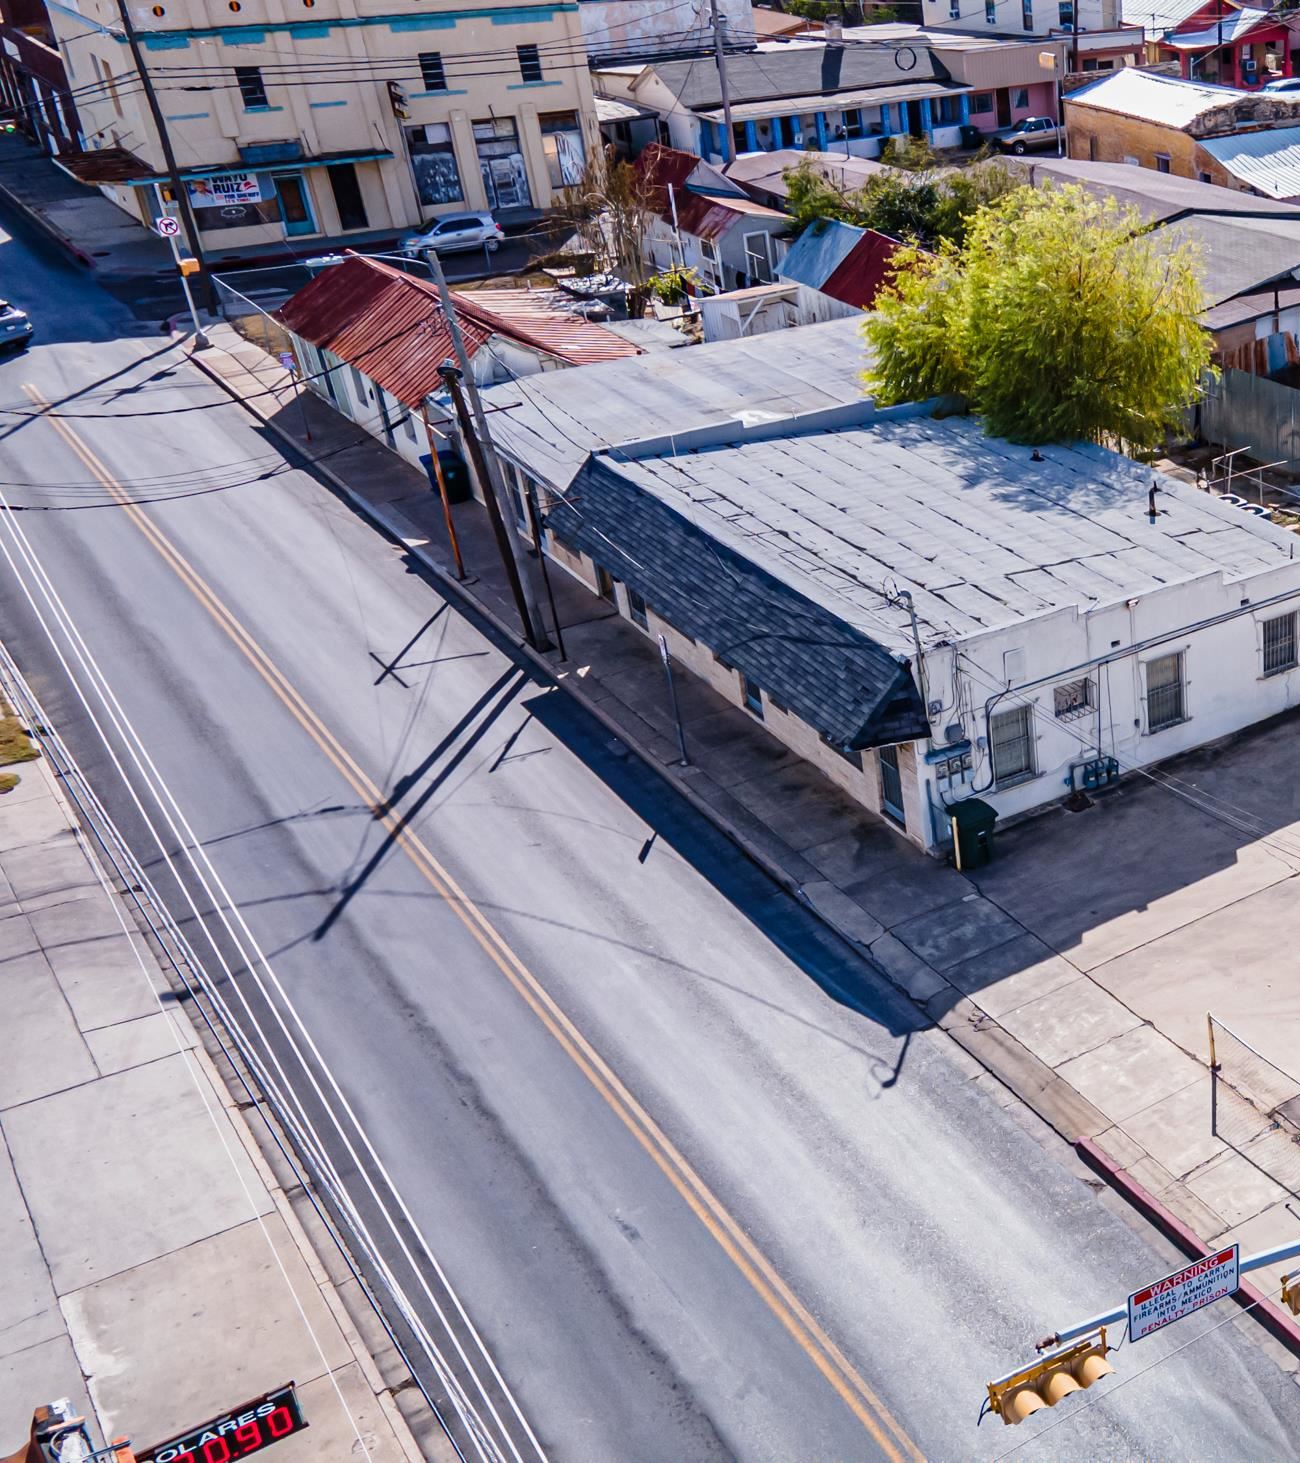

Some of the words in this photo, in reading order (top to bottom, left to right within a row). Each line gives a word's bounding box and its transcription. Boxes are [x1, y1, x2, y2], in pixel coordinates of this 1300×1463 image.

[212, 182, 243, 194] RUIZ
[1141, 1290, 1177, 1311] ILLEGAL
[1182, 1281, 1193, 1290] TO
[1197, 1264, 1226, 1282] CARRY
[1150, 1256, 1219, 1298] WARNING
[1157, 1304, 1177, 1319] INTO
[1181, 1287, 1212, 1307] MEXICO
[1192, 1287, 1228, 1309] PRISON
[141, 1401, 277, 1463] OLARES
